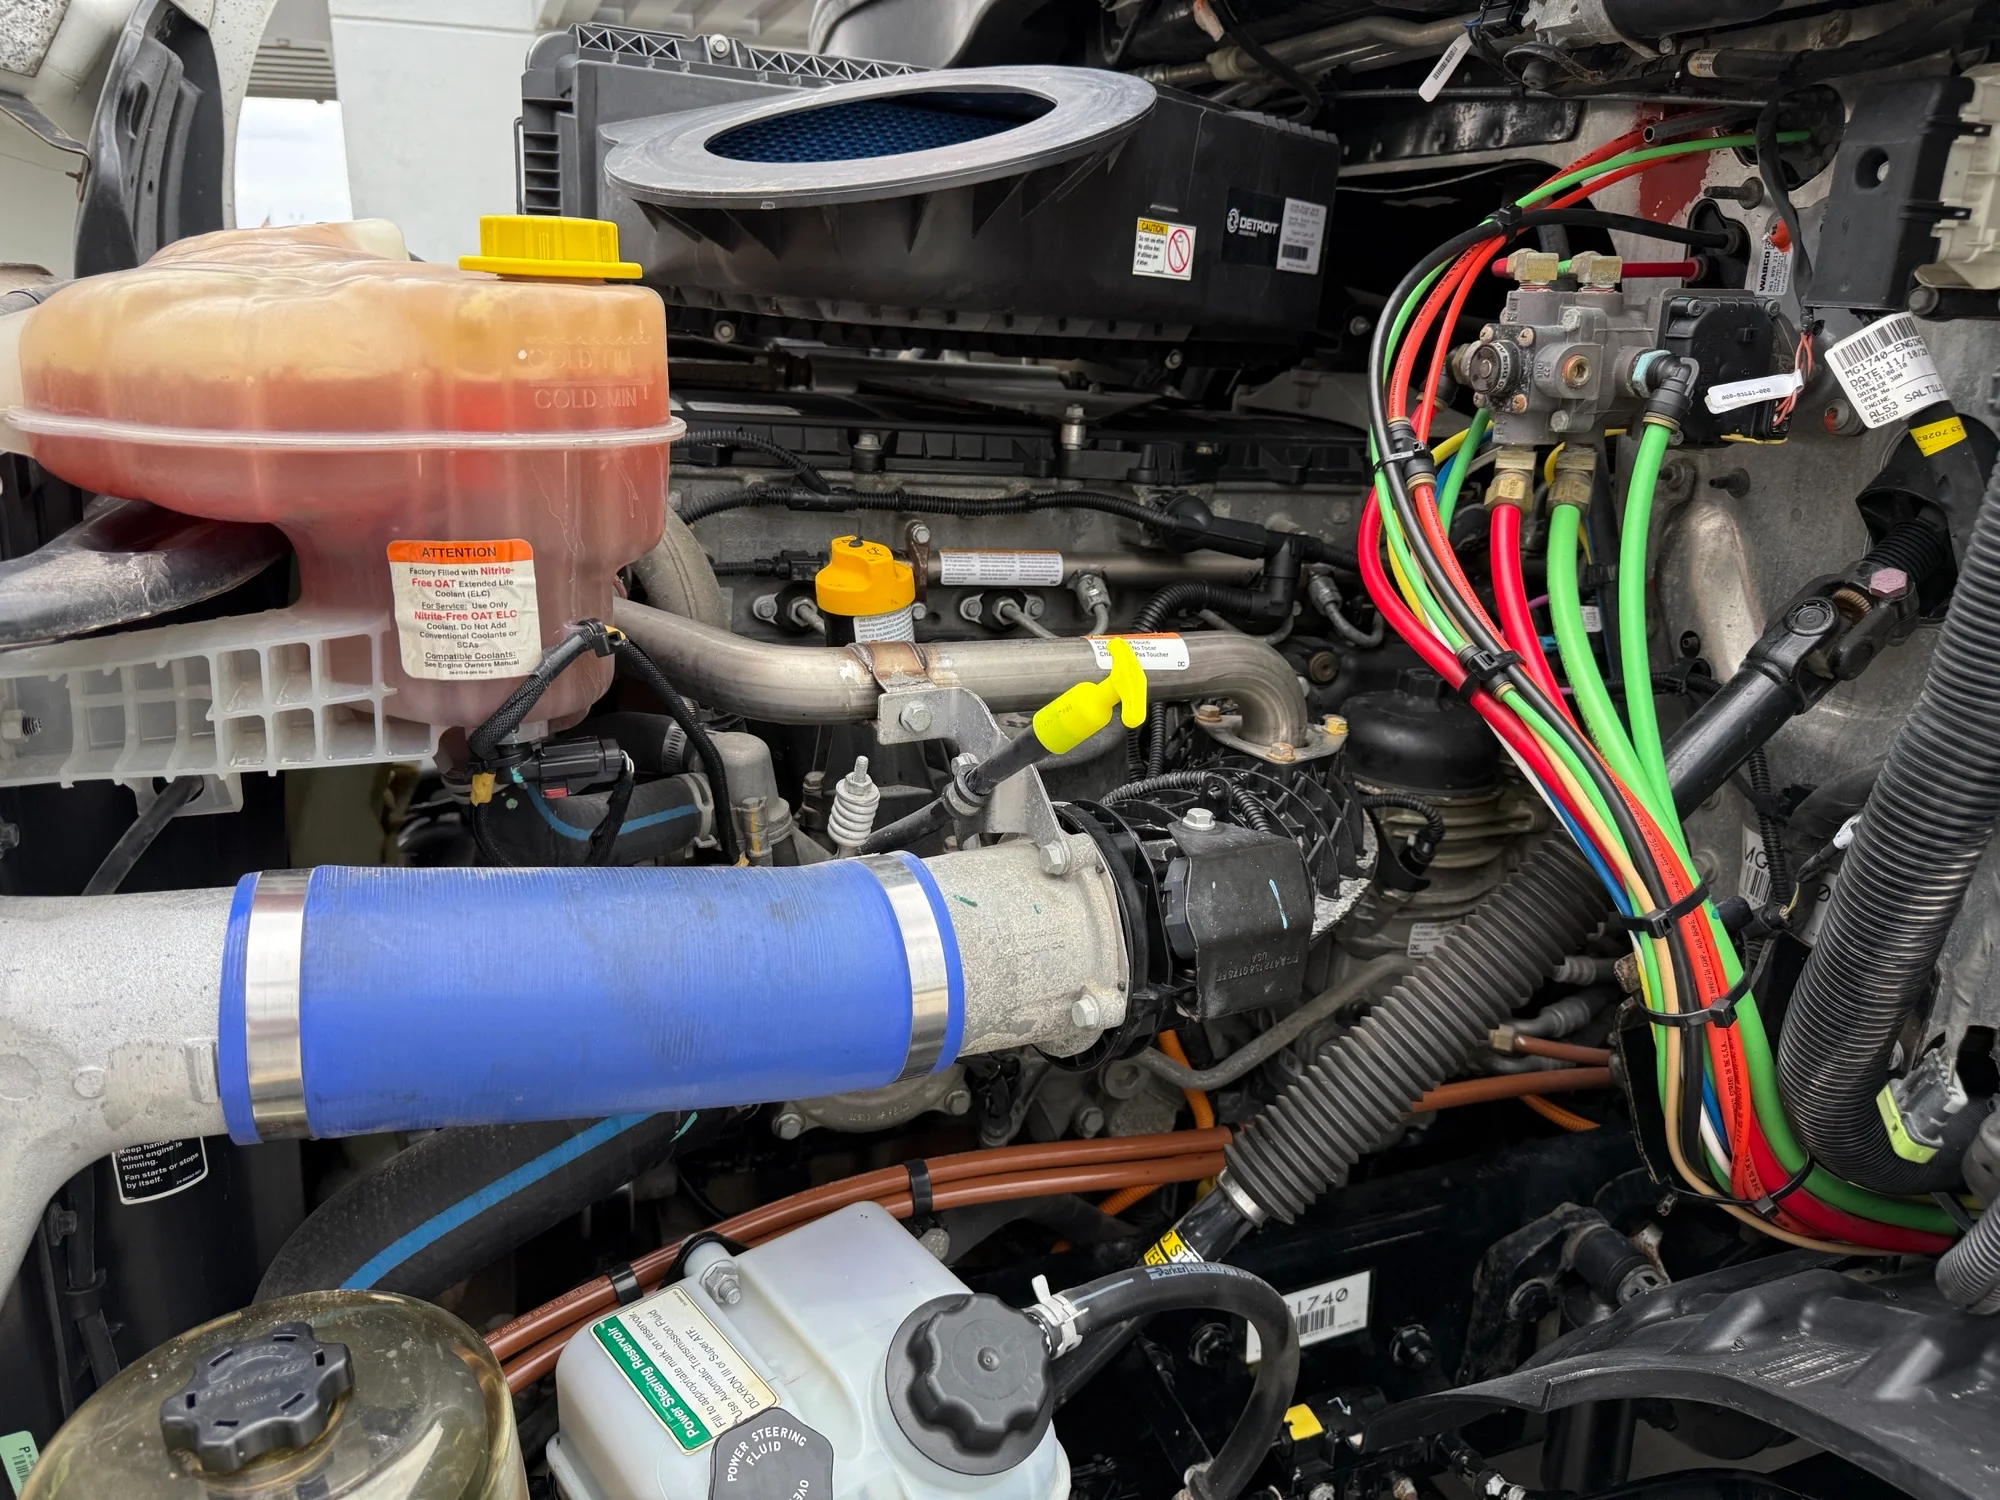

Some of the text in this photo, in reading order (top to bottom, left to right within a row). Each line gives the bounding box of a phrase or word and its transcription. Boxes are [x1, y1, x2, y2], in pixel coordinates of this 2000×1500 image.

[1142, 222, 1164, 233] CAUTION
[1239, 216, 1279, 234] DETROIT
[1759, 251, 1770, 291] WABCO
[1844, 337, 1923, 378] MG1740-ENGINE
[535, 387, 637, 409] COLD MIN
[1857, 382, 1887, 398] DAIMLER
[1860, 393, 1879, 404] OPER
[1864, 396, 1890, 411] ENGINE
[1869, 402, 1899, 419] AL53
[1873, 410, 1899, 425] MEXICO
[422, 547, 497, 557] ATTENTION
[410, 566, 514, 577] Factory Filled with Nitrite-
[412, 578, 432, 587] Free
[434, 580, 456, 588] OAT
[459, 580, 496, 588] Extended
[468, 590, 490, 598] (ELC)
[422, 602, 434, 610] For
[436, 602, 467, 610] Service:
[489, 601, 508, 610] Only
[414, 610, 517, 620] Nitrite-Free OAT ELC
[419, 631, 469, 639] Conventional
[425, 651, 516, 660] Compatible Coolants:
[494, 659, 519, 667] Manual
[120, 1145, 141, 1154] Keep
[121, 1155, 143, 1163] when
[146, 1146, 174, 1158] engine
[122, 1159, 158, 1170] running.
[142, 1167, 167, 1178] starts
[179, 1152, 199, 1166] stops
[138, 1176, 163, 1186] itself.
[1158, 1265, 1185, 1276] Parker
[1287, 1288, 1348, 1314] 1740
[647, 1309, 663, 1326] Fluid
[499, 1321, 518, 1334] TEMP
[685, 1326, 702, 1345] ATF.
[663, 1327, 701, 1370] Transmission
[700, 1342, 719, 1362] Super
[628, 1310, 726, 1429] Fill to appropriate mark on reservoir.
[722, 1367, 731, 1378] III
[607, 1327, 700, 1439] Power Steering Reservoir
[698, 1368, 731, 1404] Automatic
[727, 1375, 761, 1410] DEXRON
[727, 1401, 743, 1421] Use
[727, 1427, 807, 1482] POWER STEERING
[746, 1441, 781, 1466] FLUID
[792, 1480, 809, 1500] OVE
